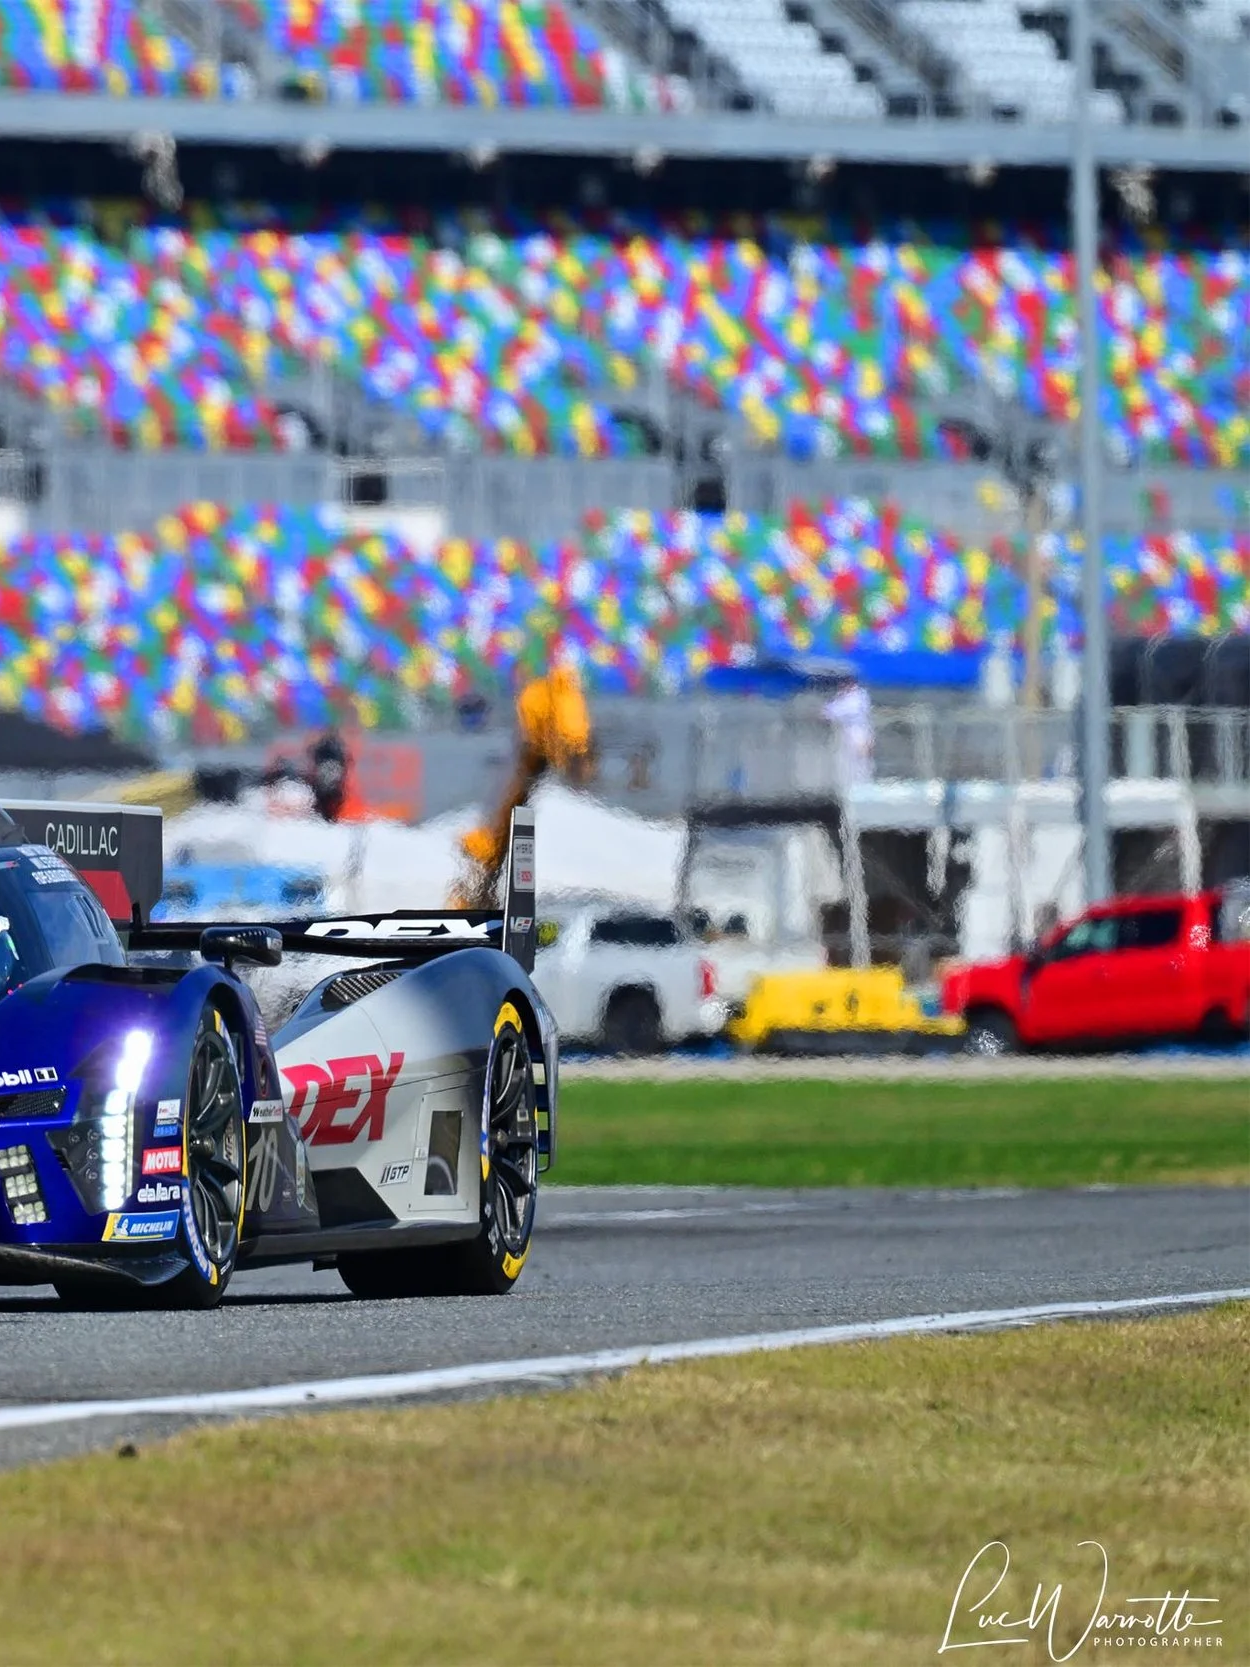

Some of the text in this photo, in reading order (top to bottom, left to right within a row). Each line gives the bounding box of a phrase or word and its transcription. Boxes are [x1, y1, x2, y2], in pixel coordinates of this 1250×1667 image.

[45, 822, 119, 857] CADILLAC
[303, 918, 506, 939] DEX
[280, 1052, 405, 1147] DEX
[144, 1149, 181, 1171] MOTUL
[245, 1127, 278, 1213] 10
[389, 1164, 410, 1181] GTP
[137, 1182, 181, 1203] dallara
[130, 1219, 175, 1234] MICHELIN
